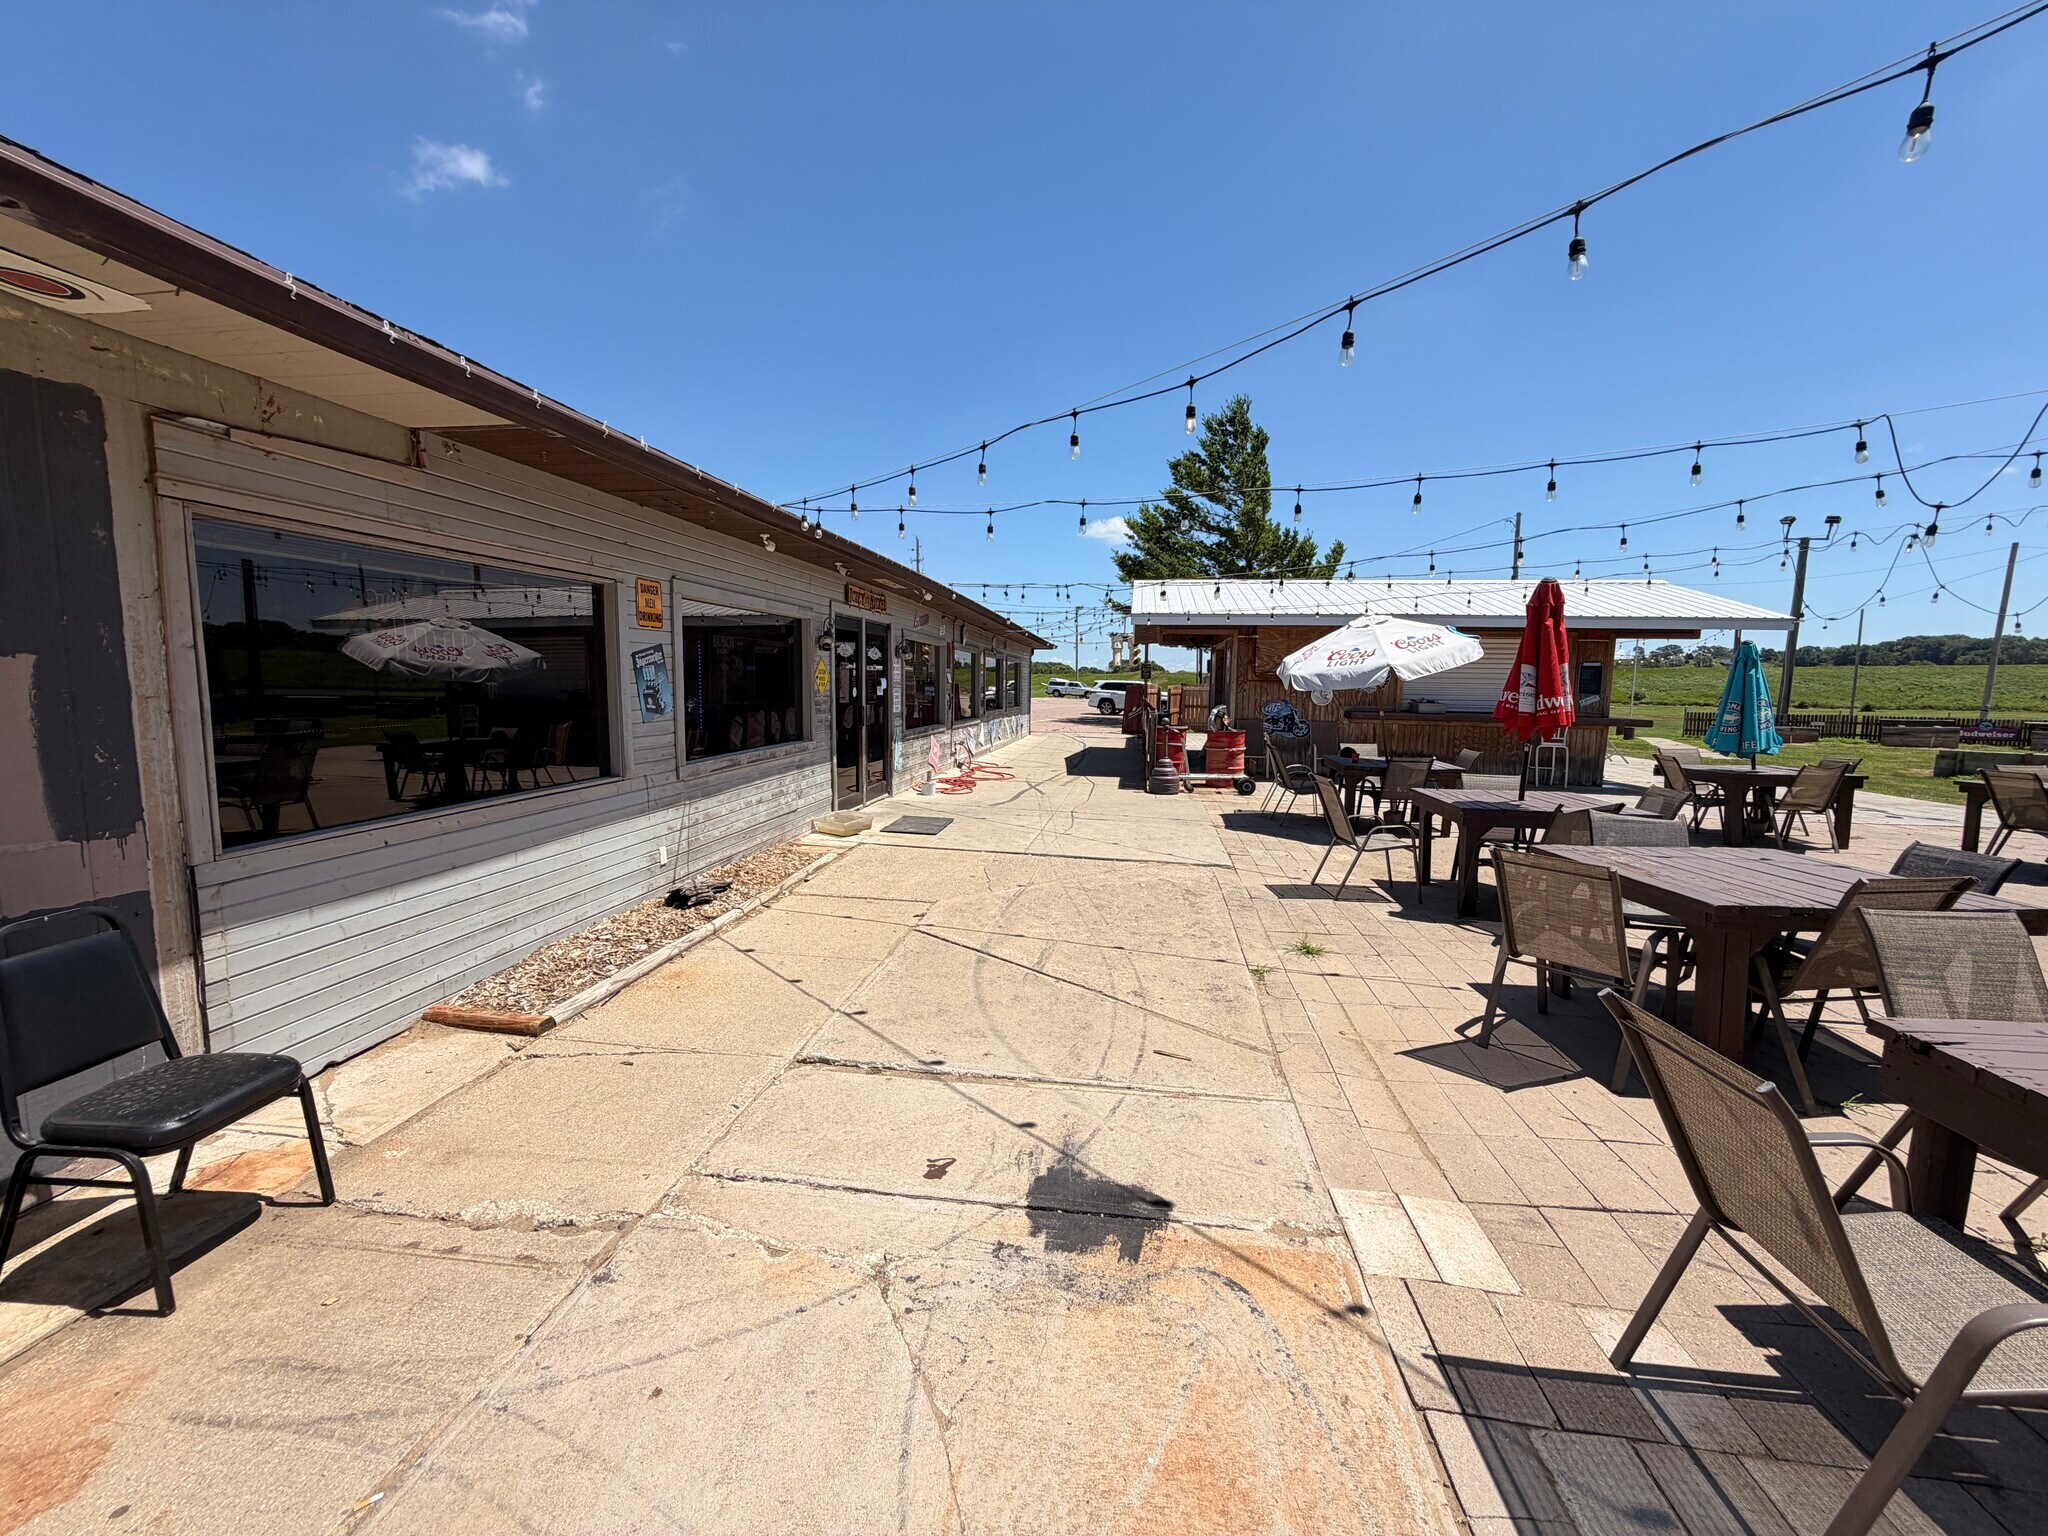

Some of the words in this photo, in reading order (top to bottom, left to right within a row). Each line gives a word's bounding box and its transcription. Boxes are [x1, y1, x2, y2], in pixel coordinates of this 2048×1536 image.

[640, 583, 659, 596] DANGER
[644, 597, 655, 609] MEN
[639, 611, 662, 623] DRINKING
[1394, 633, 1442, 650] Coors
[1407, 640, 1445, 654] LIGHT
[1327, 648, 1377, 661] Coors
[1327, 658, 1367, 667] LIGHT
